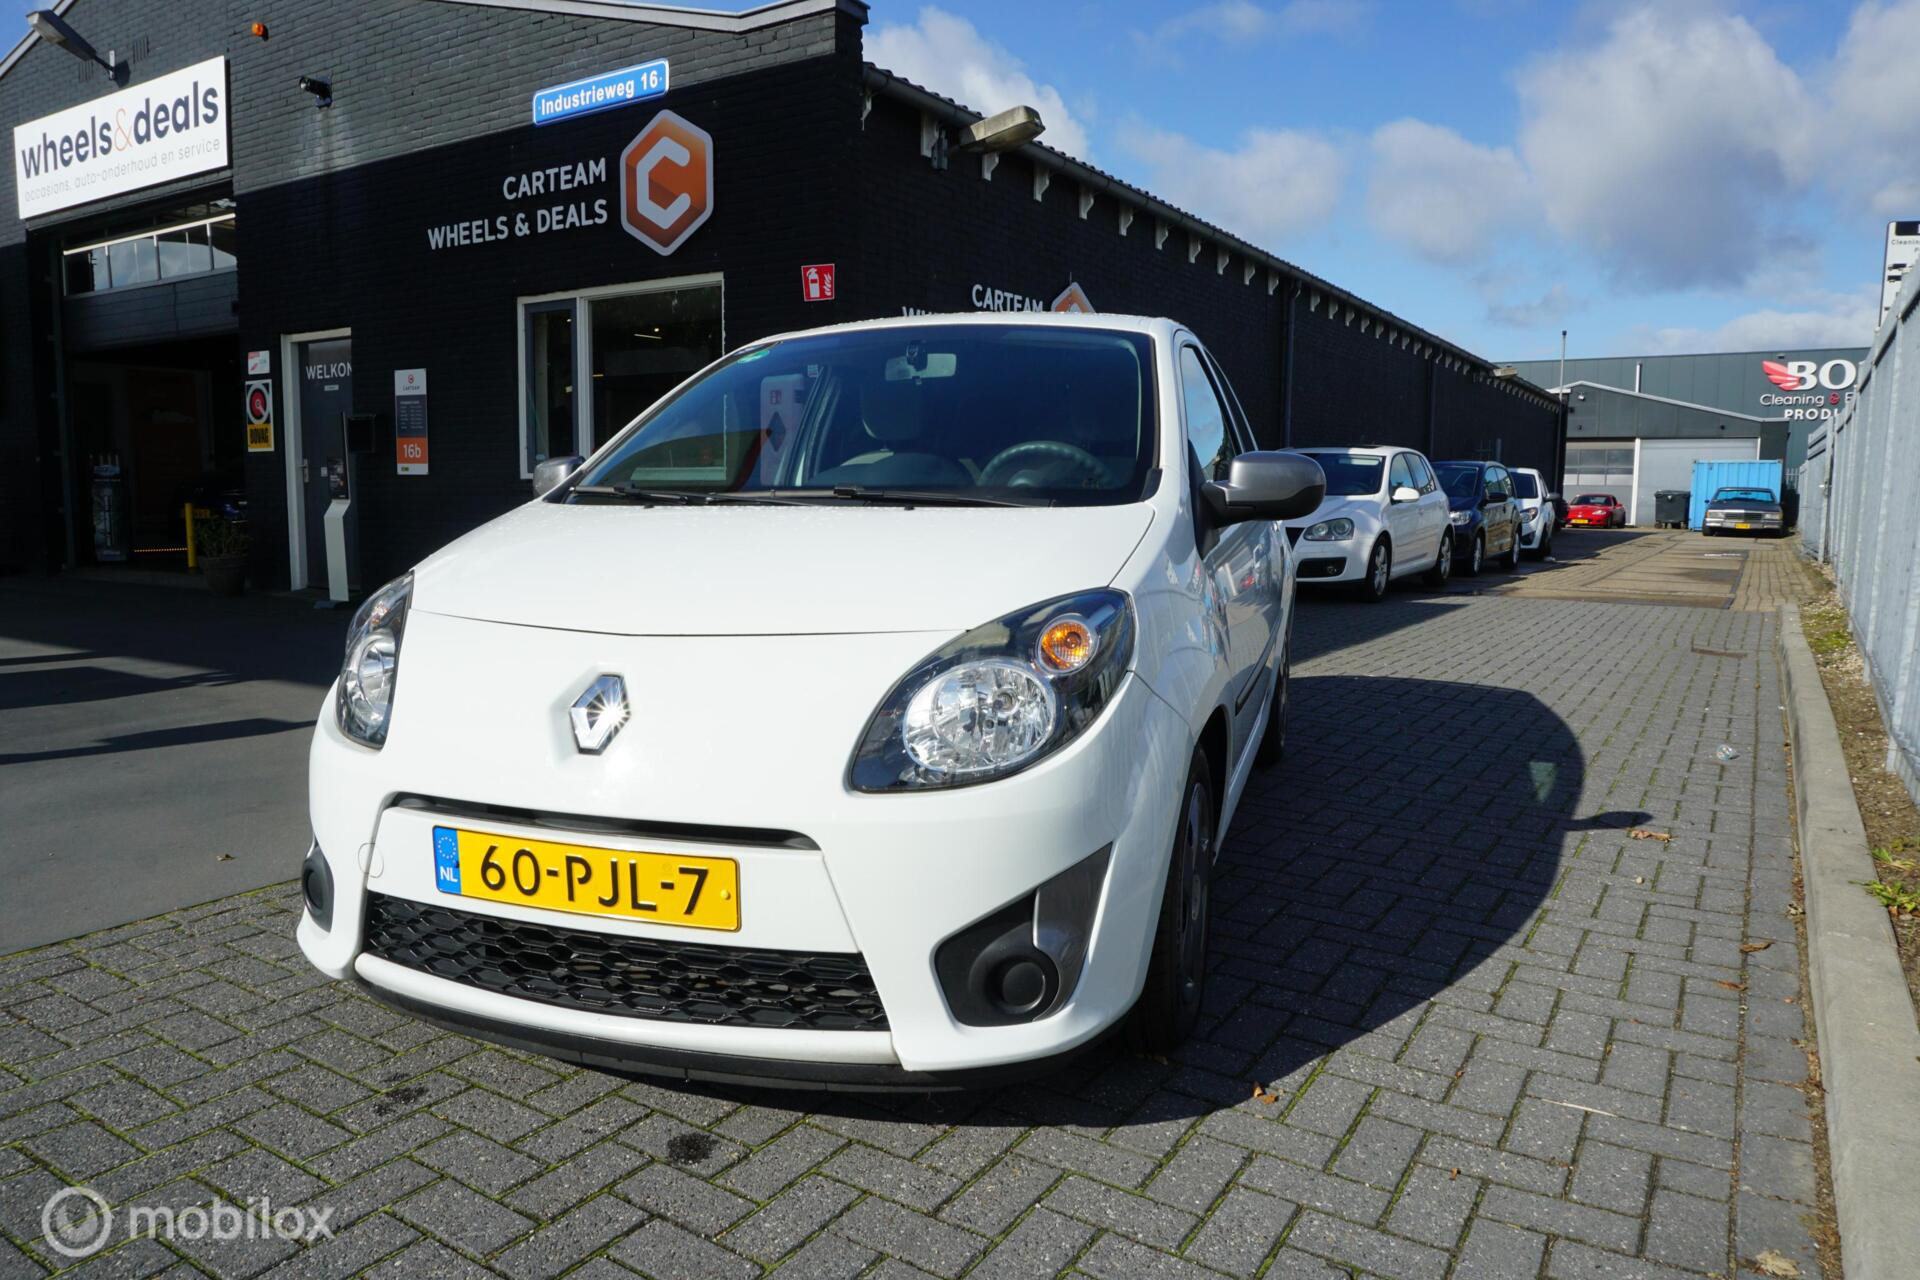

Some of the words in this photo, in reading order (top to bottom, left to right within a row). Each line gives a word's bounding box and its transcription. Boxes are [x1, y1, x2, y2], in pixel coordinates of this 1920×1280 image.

[540, 78, 635, 116] Industrieweg
[640, 70, 660, 91] 16
[160, 151, 174, 167] en
[178, 138, 221, 162] service
[503, 157, 607, 200] CARTEAM
[427, 215, 509, 251] WHEELS
[514, 211, 530, 238] &
[536, 199, 608, 232] DEALS
[1760, 393, 1825, 408] Cleaning
[402, 443, 422, 459] 16b
[440, 865, 458, 883] NL
[480, 845, 709, 916] 60-PJL-7
